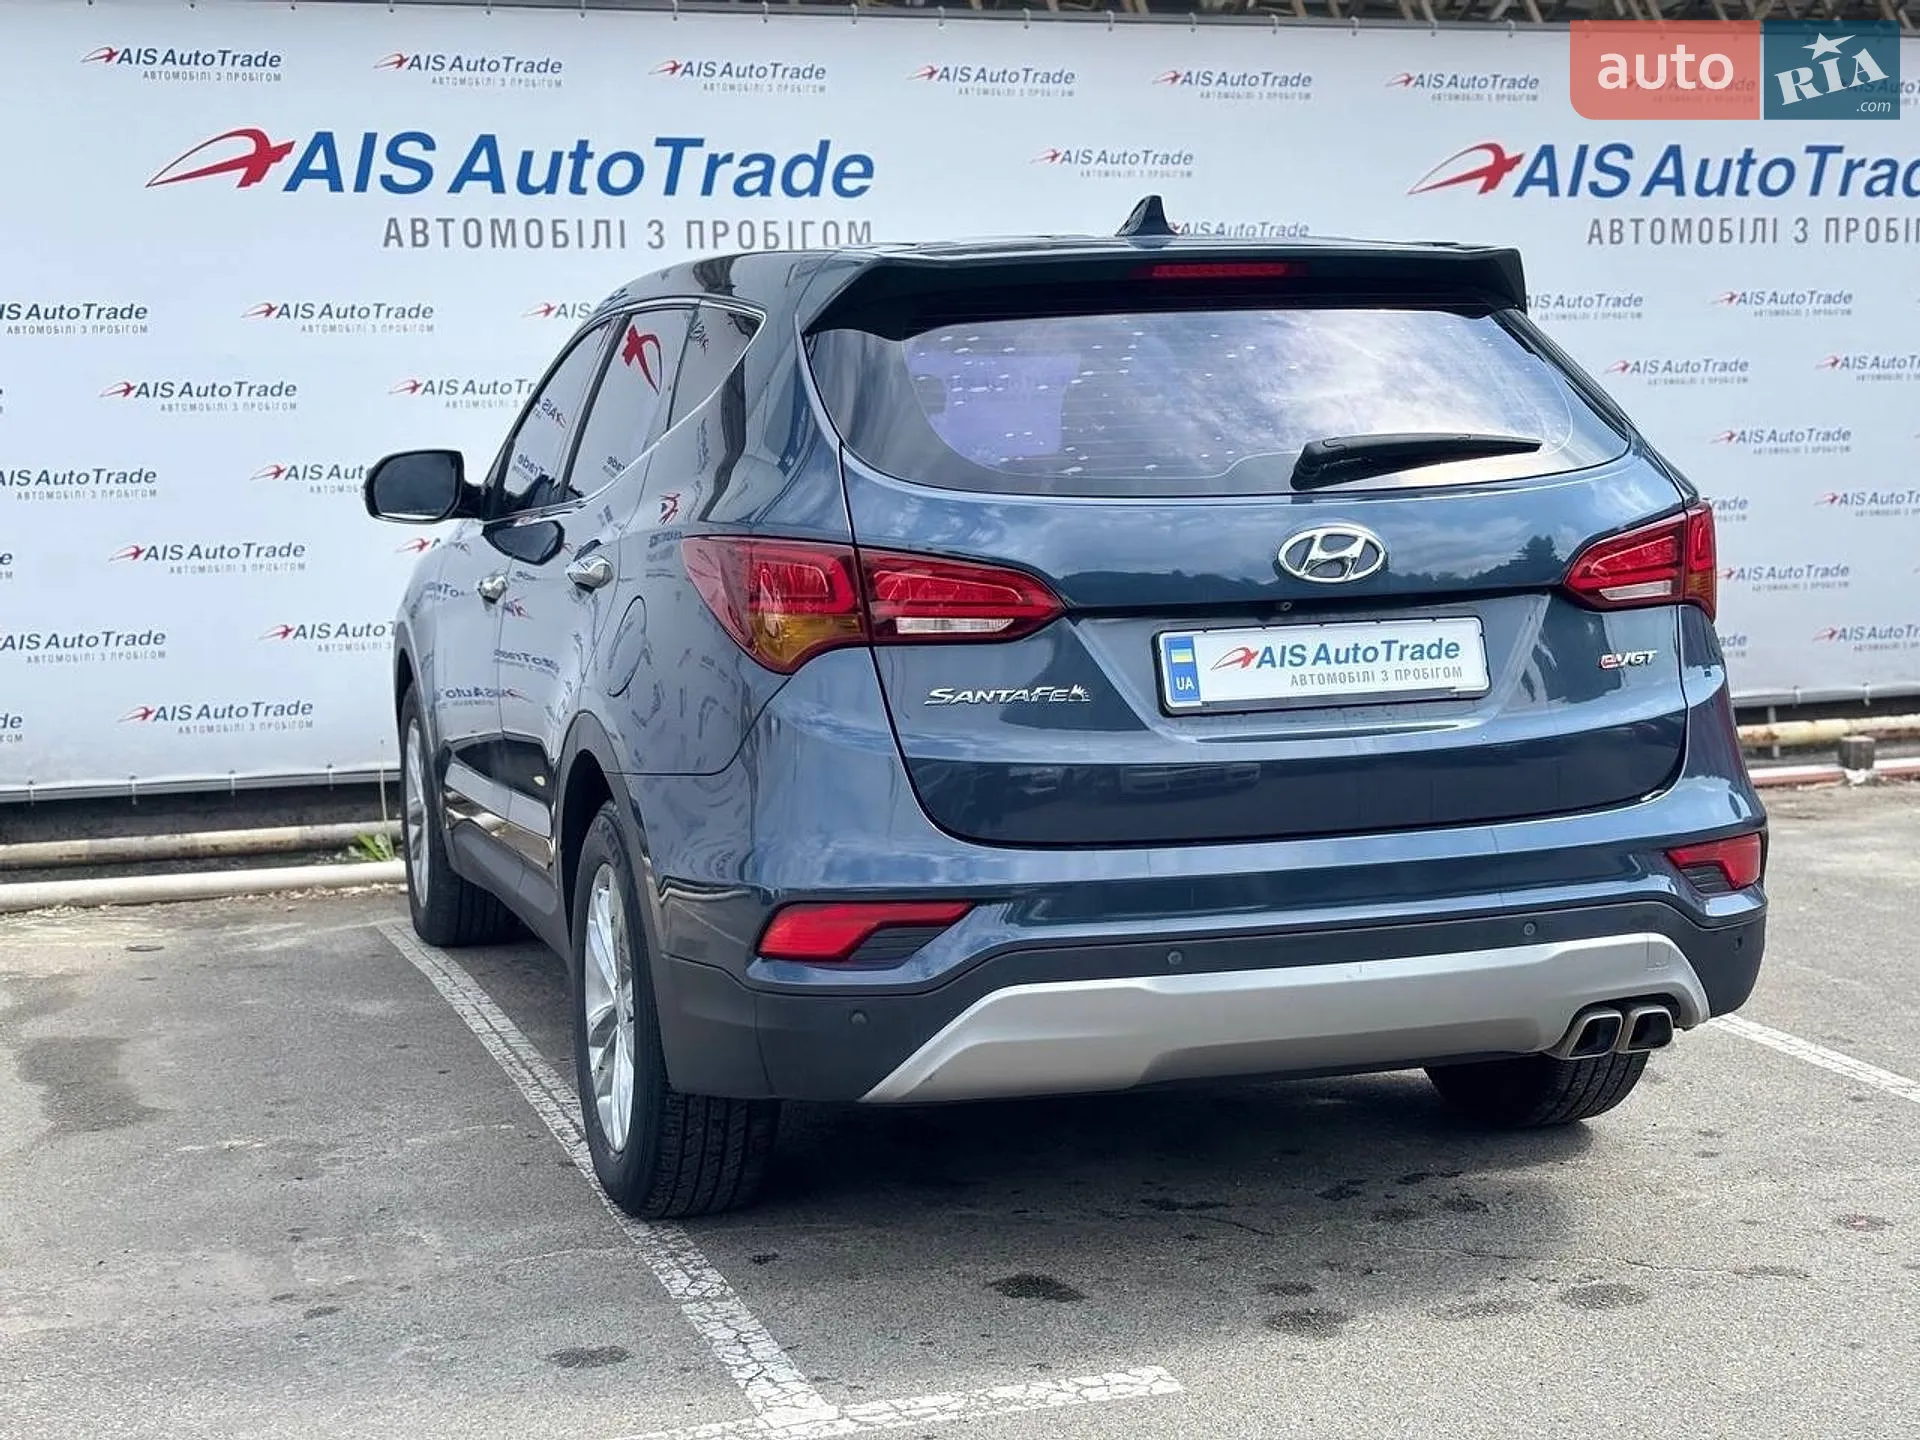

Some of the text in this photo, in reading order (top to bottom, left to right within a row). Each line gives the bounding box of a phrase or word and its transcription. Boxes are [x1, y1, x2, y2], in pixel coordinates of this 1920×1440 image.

[117, 48, 281, 68] AIS AutoTrade
[408, 54, 562, 74] AIS AutoTrade
[681, 61, 826, 80] AIS AutoTrade
[937, 66, 975, 83] AIS
[1180, 71, 1218, 86] AIS
[284, 132, 874, 198] AIS AutoTrade
[1060, 149, 1097, 165] AIS
[1513, 143, 1633, 198] AIS
[383, 217, 872, 249] АВТОМОБІЛІ З ПРОБІГОМ
[1588, 217, 1777, 245] АВТОМОБІЛІ
[0, 303, 22, 320] IS
[276, 303, 433, 319] AIS AutoTrade
[554, 303, 592, 320] AIS
[7, 325, 75, 335] АВТОМОБІЛІ
[92, 324, 148, 335] ПРОБІГОМ
[134, 381, 296, 398] AIS AutoTrade
[421, 379, 535, 396] AIS AutoTr
[0, 468, 156, 486] AIS AutoTrade
[284, 464, 323, 480] AIS
[143, 542, 305, 561] AIS AutoTrade
[292, 623, 331, 639] AIS
[0, 630, 165, 651] AIS AutoTrade
[1256, 638, 1460, 669] AIS AutoTrade
[1175, 677, 1195, 691] UA
[1290, 666, 1463, 687] АВТОМОБІЛІ З ПРОБІГОМ
[153, 700, 313, 721] AIS AutoTrade
